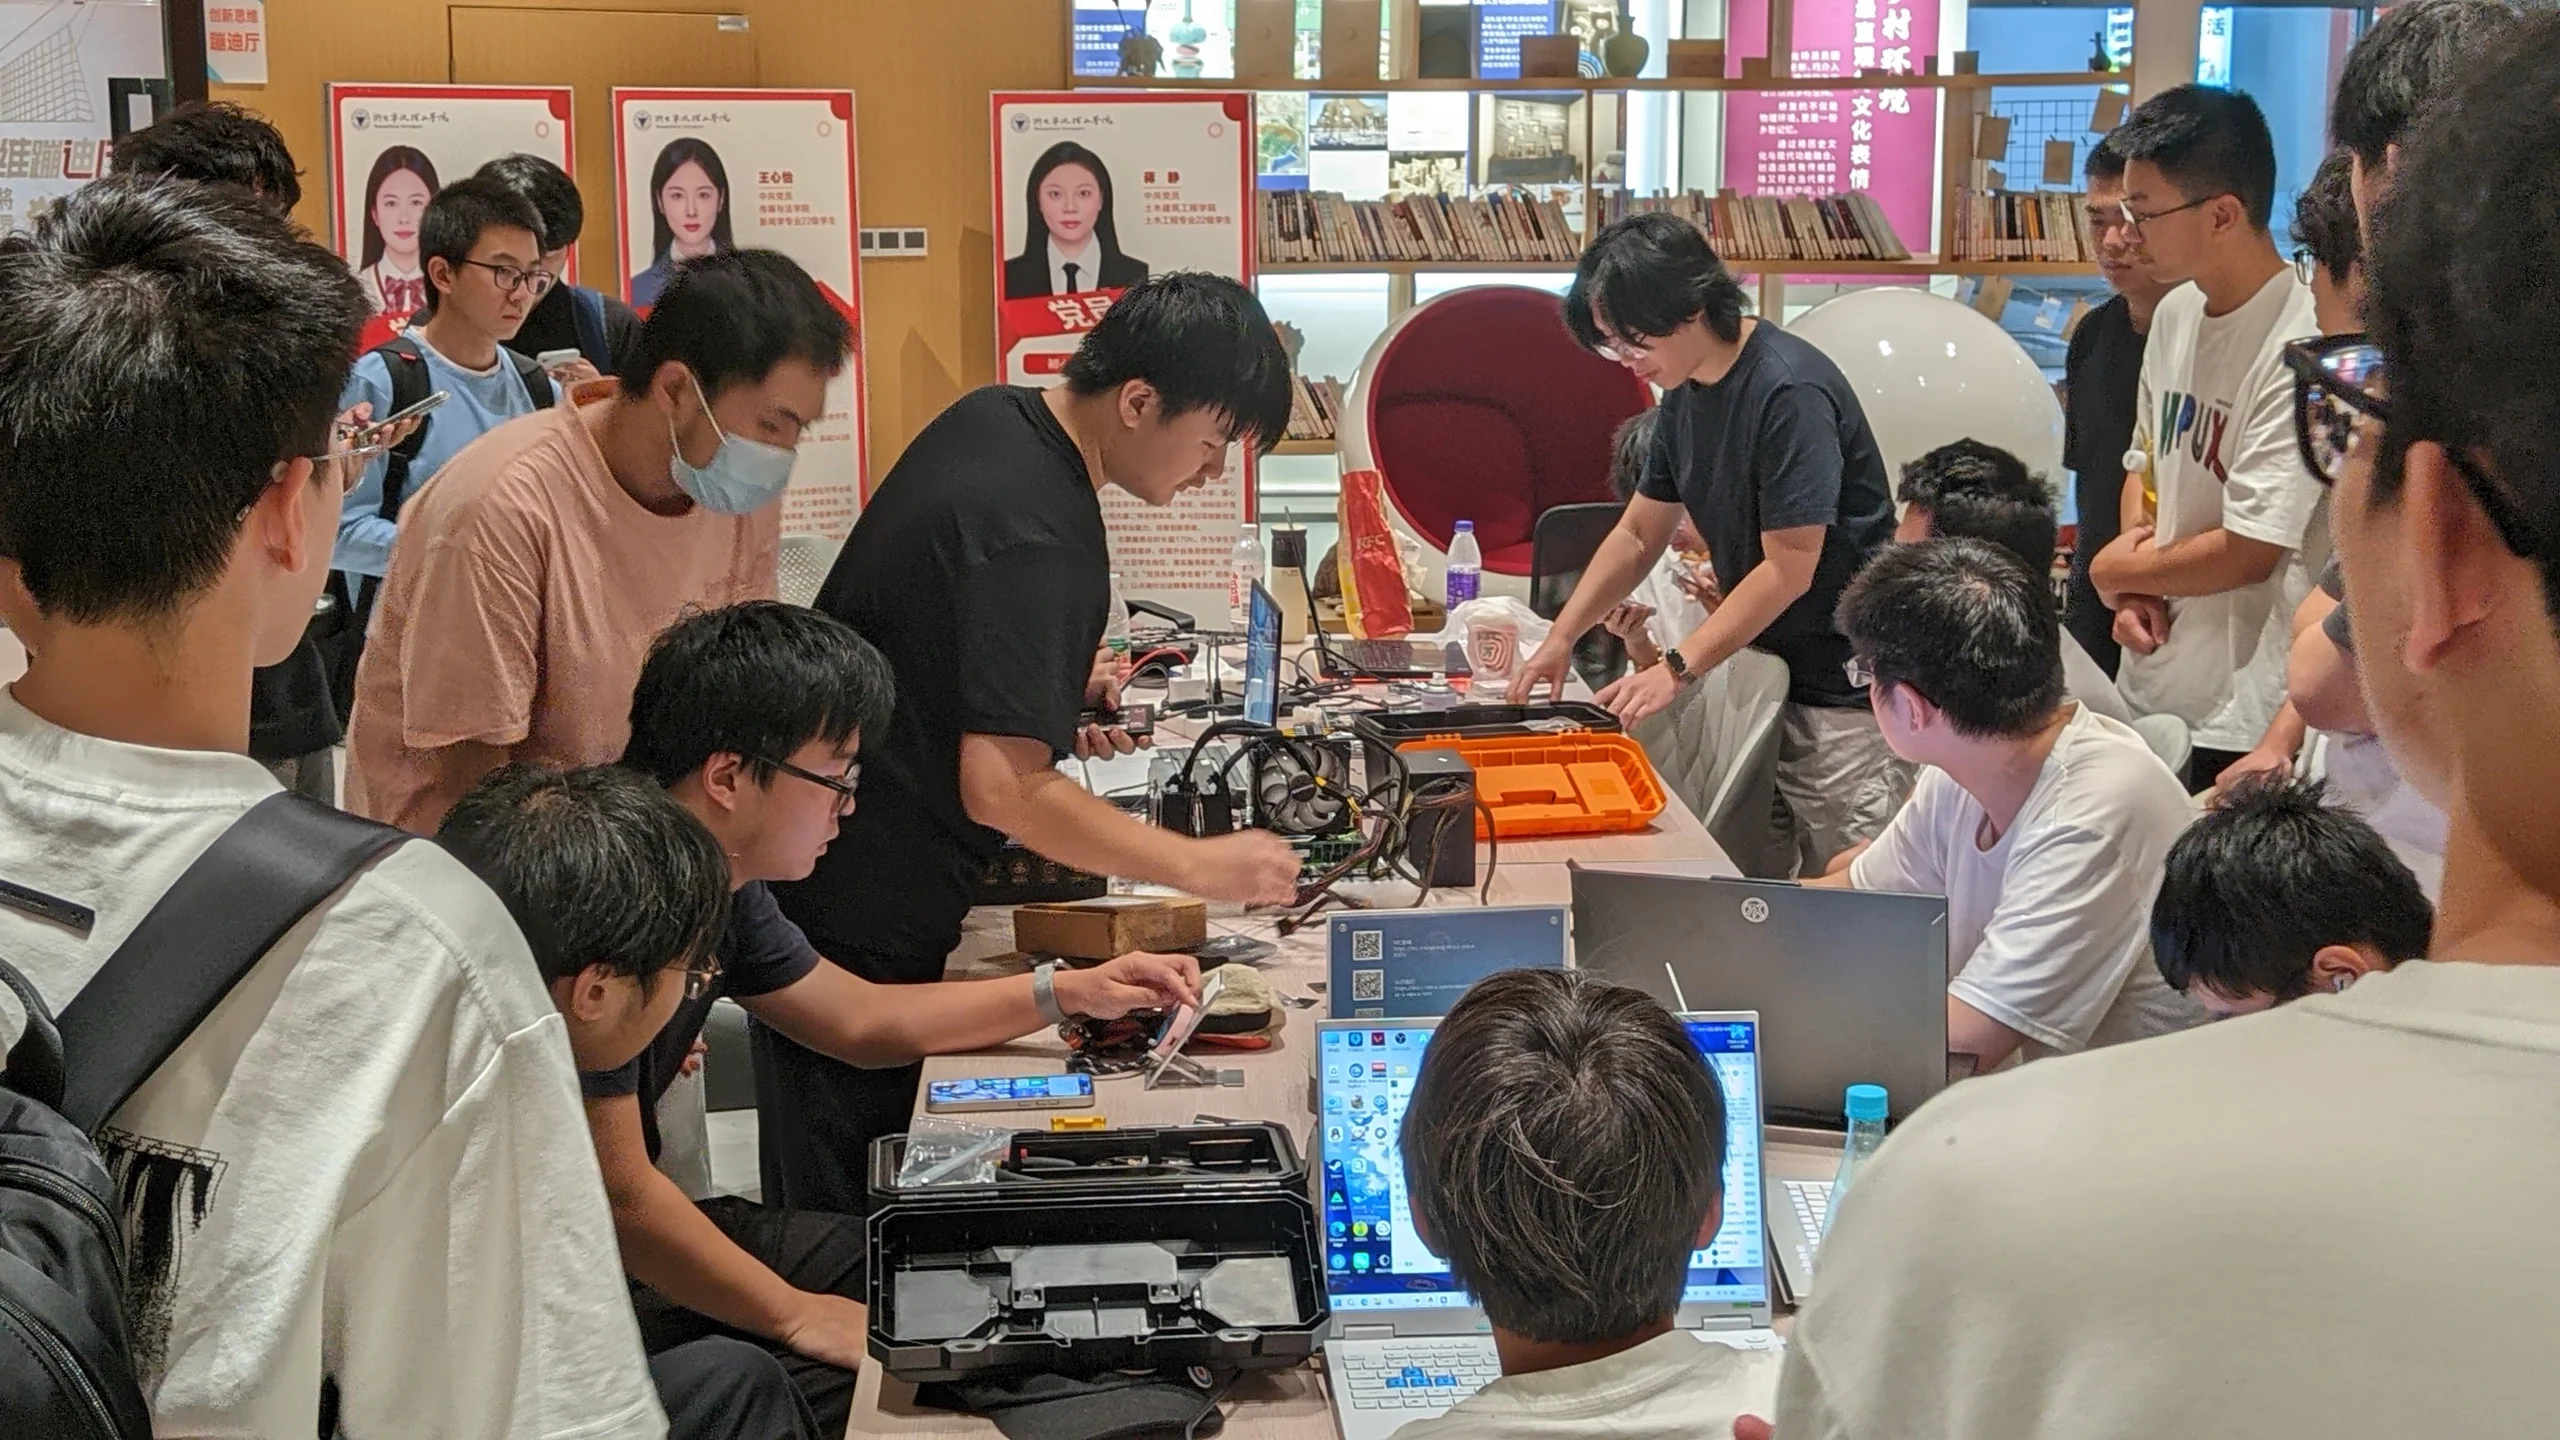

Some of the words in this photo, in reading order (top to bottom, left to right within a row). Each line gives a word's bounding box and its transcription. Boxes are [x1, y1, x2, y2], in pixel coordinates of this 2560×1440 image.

[209, 8, 258, 23] 创新思维
[209, 32, 260, 52] 蹦迪厅
[1878, 0, 1912, 114] 村环境
[758, 171, 794, 184] 王心怡
[758, 192, 793, 201] 中共党员
[1143, 191, 1181, 201] 中共党员
[758, 204, 811, 214] 传媒与法学院
[1144, 203, 1217, 213] 土木建筑工程学院
[1144, 215, 1232, 226] 土木工程专业22级学生
